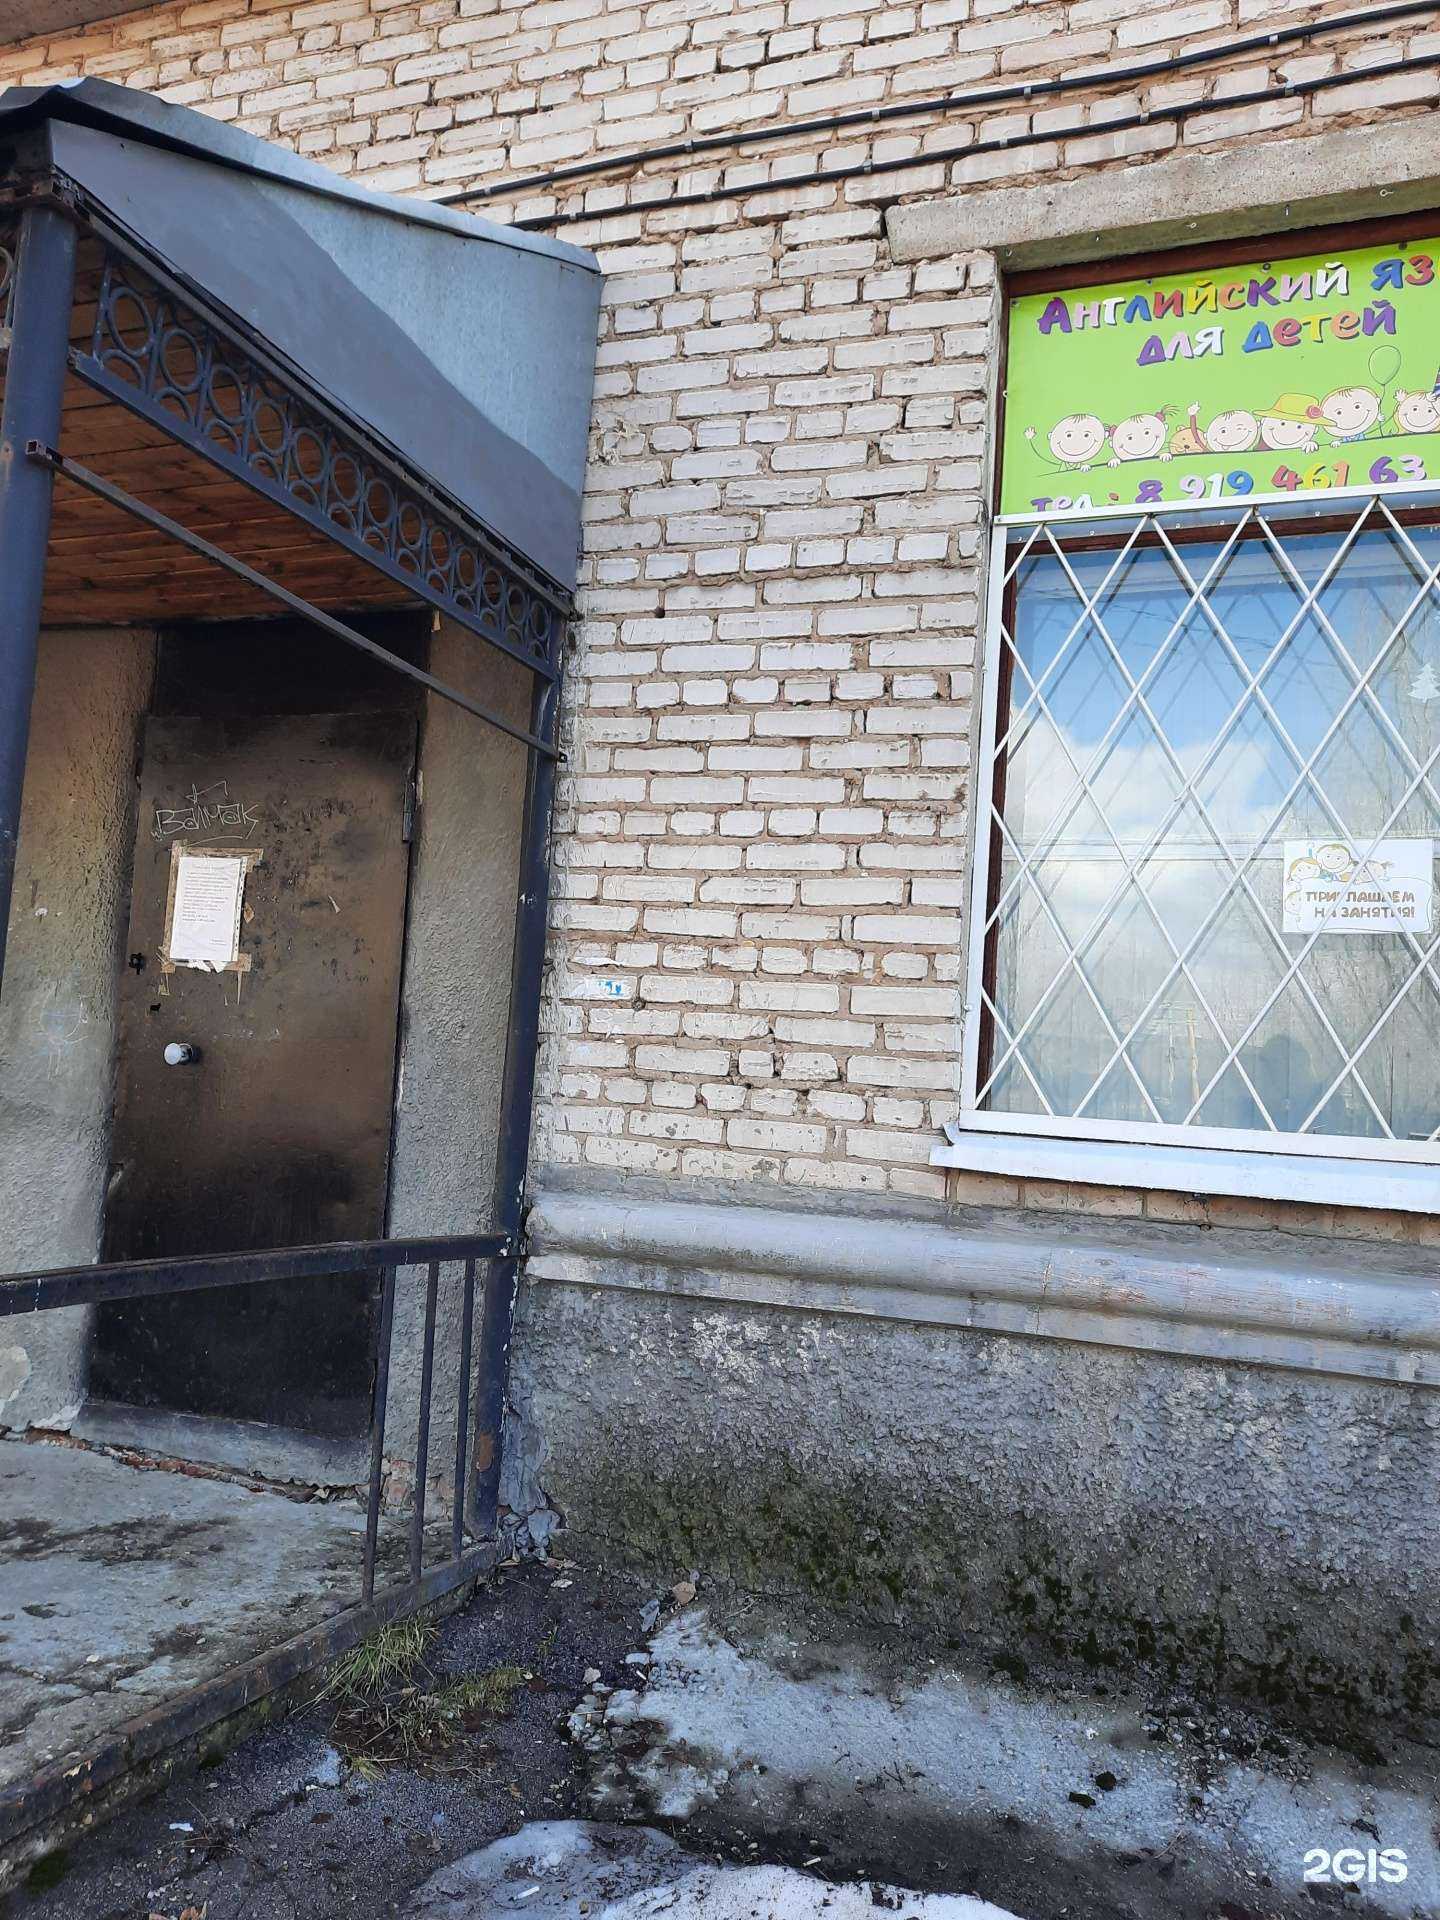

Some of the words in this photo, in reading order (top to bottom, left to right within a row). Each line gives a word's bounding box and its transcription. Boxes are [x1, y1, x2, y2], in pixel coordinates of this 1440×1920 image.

[1037, 262, 1349, 334] Английский
[1370, 255, 1440, 291] яз
[1136, 326, 1224, 366] для
[1242, 300, 1396, 353] детей
[1135, 480, 1163, 503] 8
[1180, 470, 1254, 499] 919
[1271, 460, 1349, 491] 461
[1369, 454, 1427, 484] 63
[1305, 890, 1415, 903] ПРИЛАШЕМ
